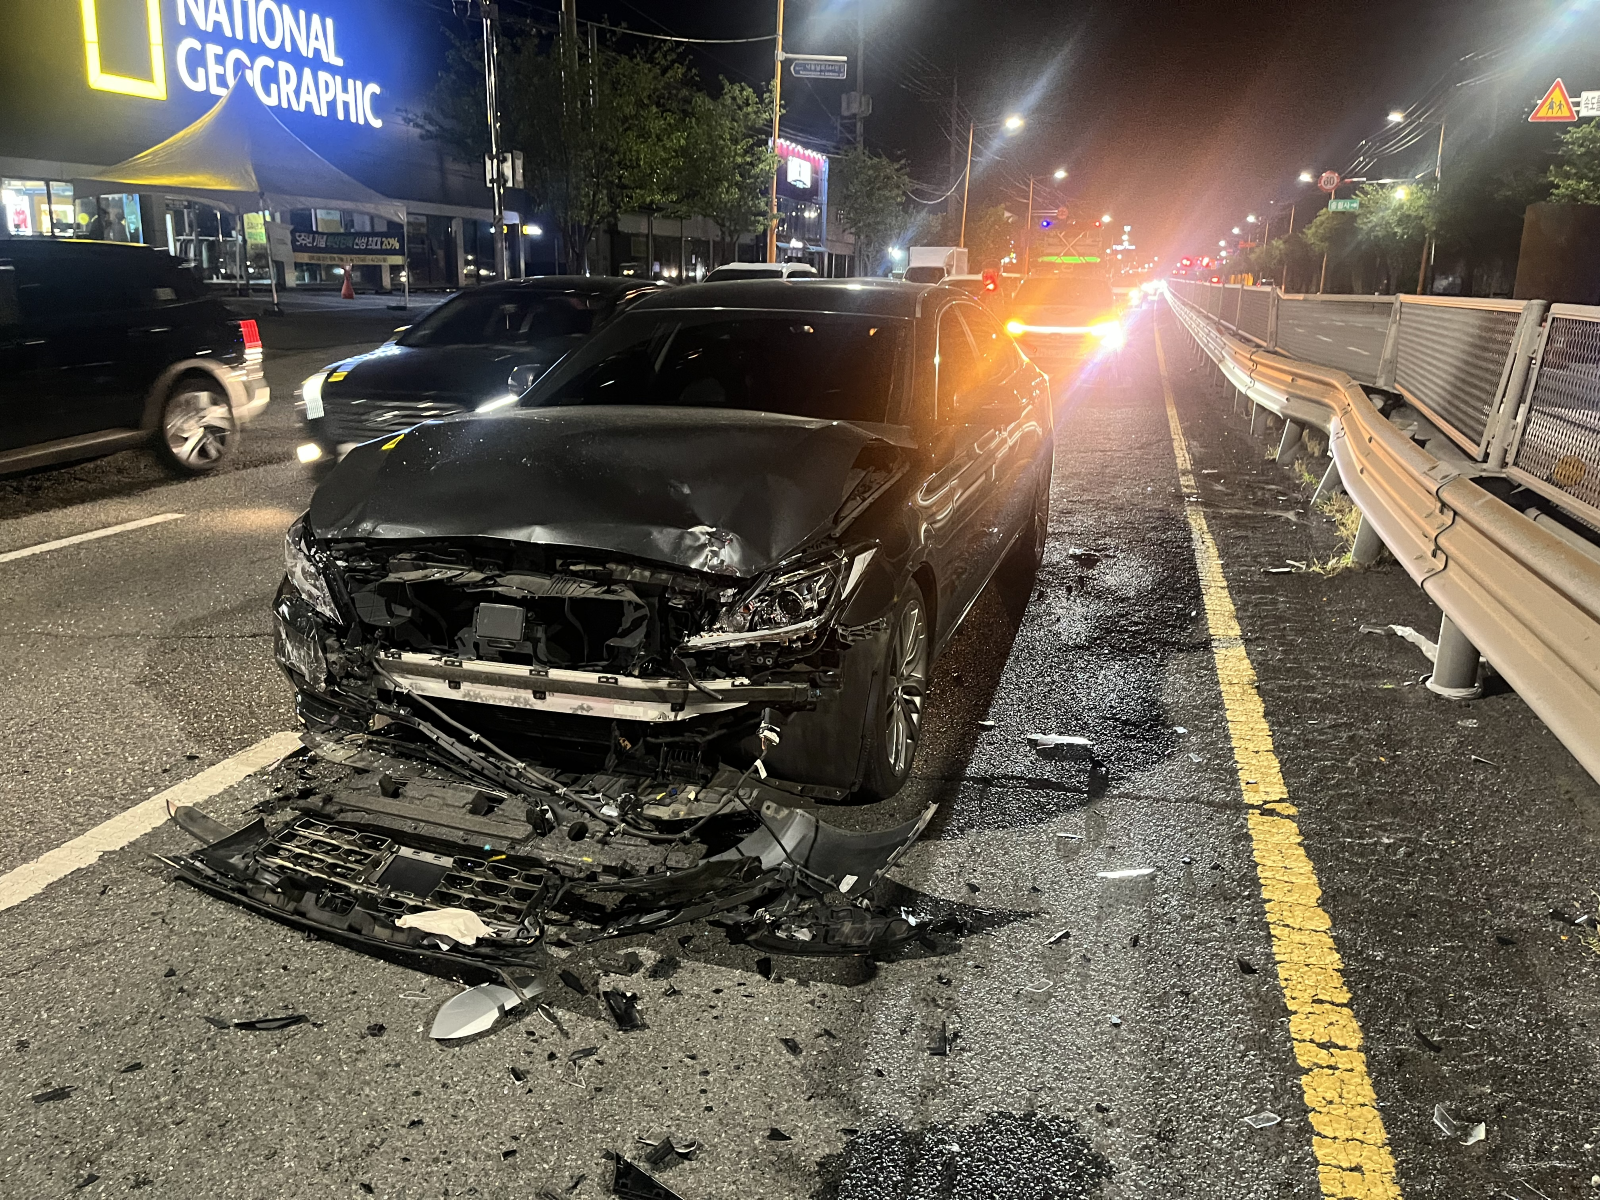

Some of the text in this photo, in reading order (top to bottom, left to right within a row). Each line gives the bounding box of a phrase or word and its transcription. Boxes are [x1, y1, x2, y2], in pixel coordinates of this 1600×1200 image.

[177, 0, 343, 67] NATIONAL
[177, 38, 383, 129] GEOGRAPHIC
[382, 237, 400, 250] 20%
